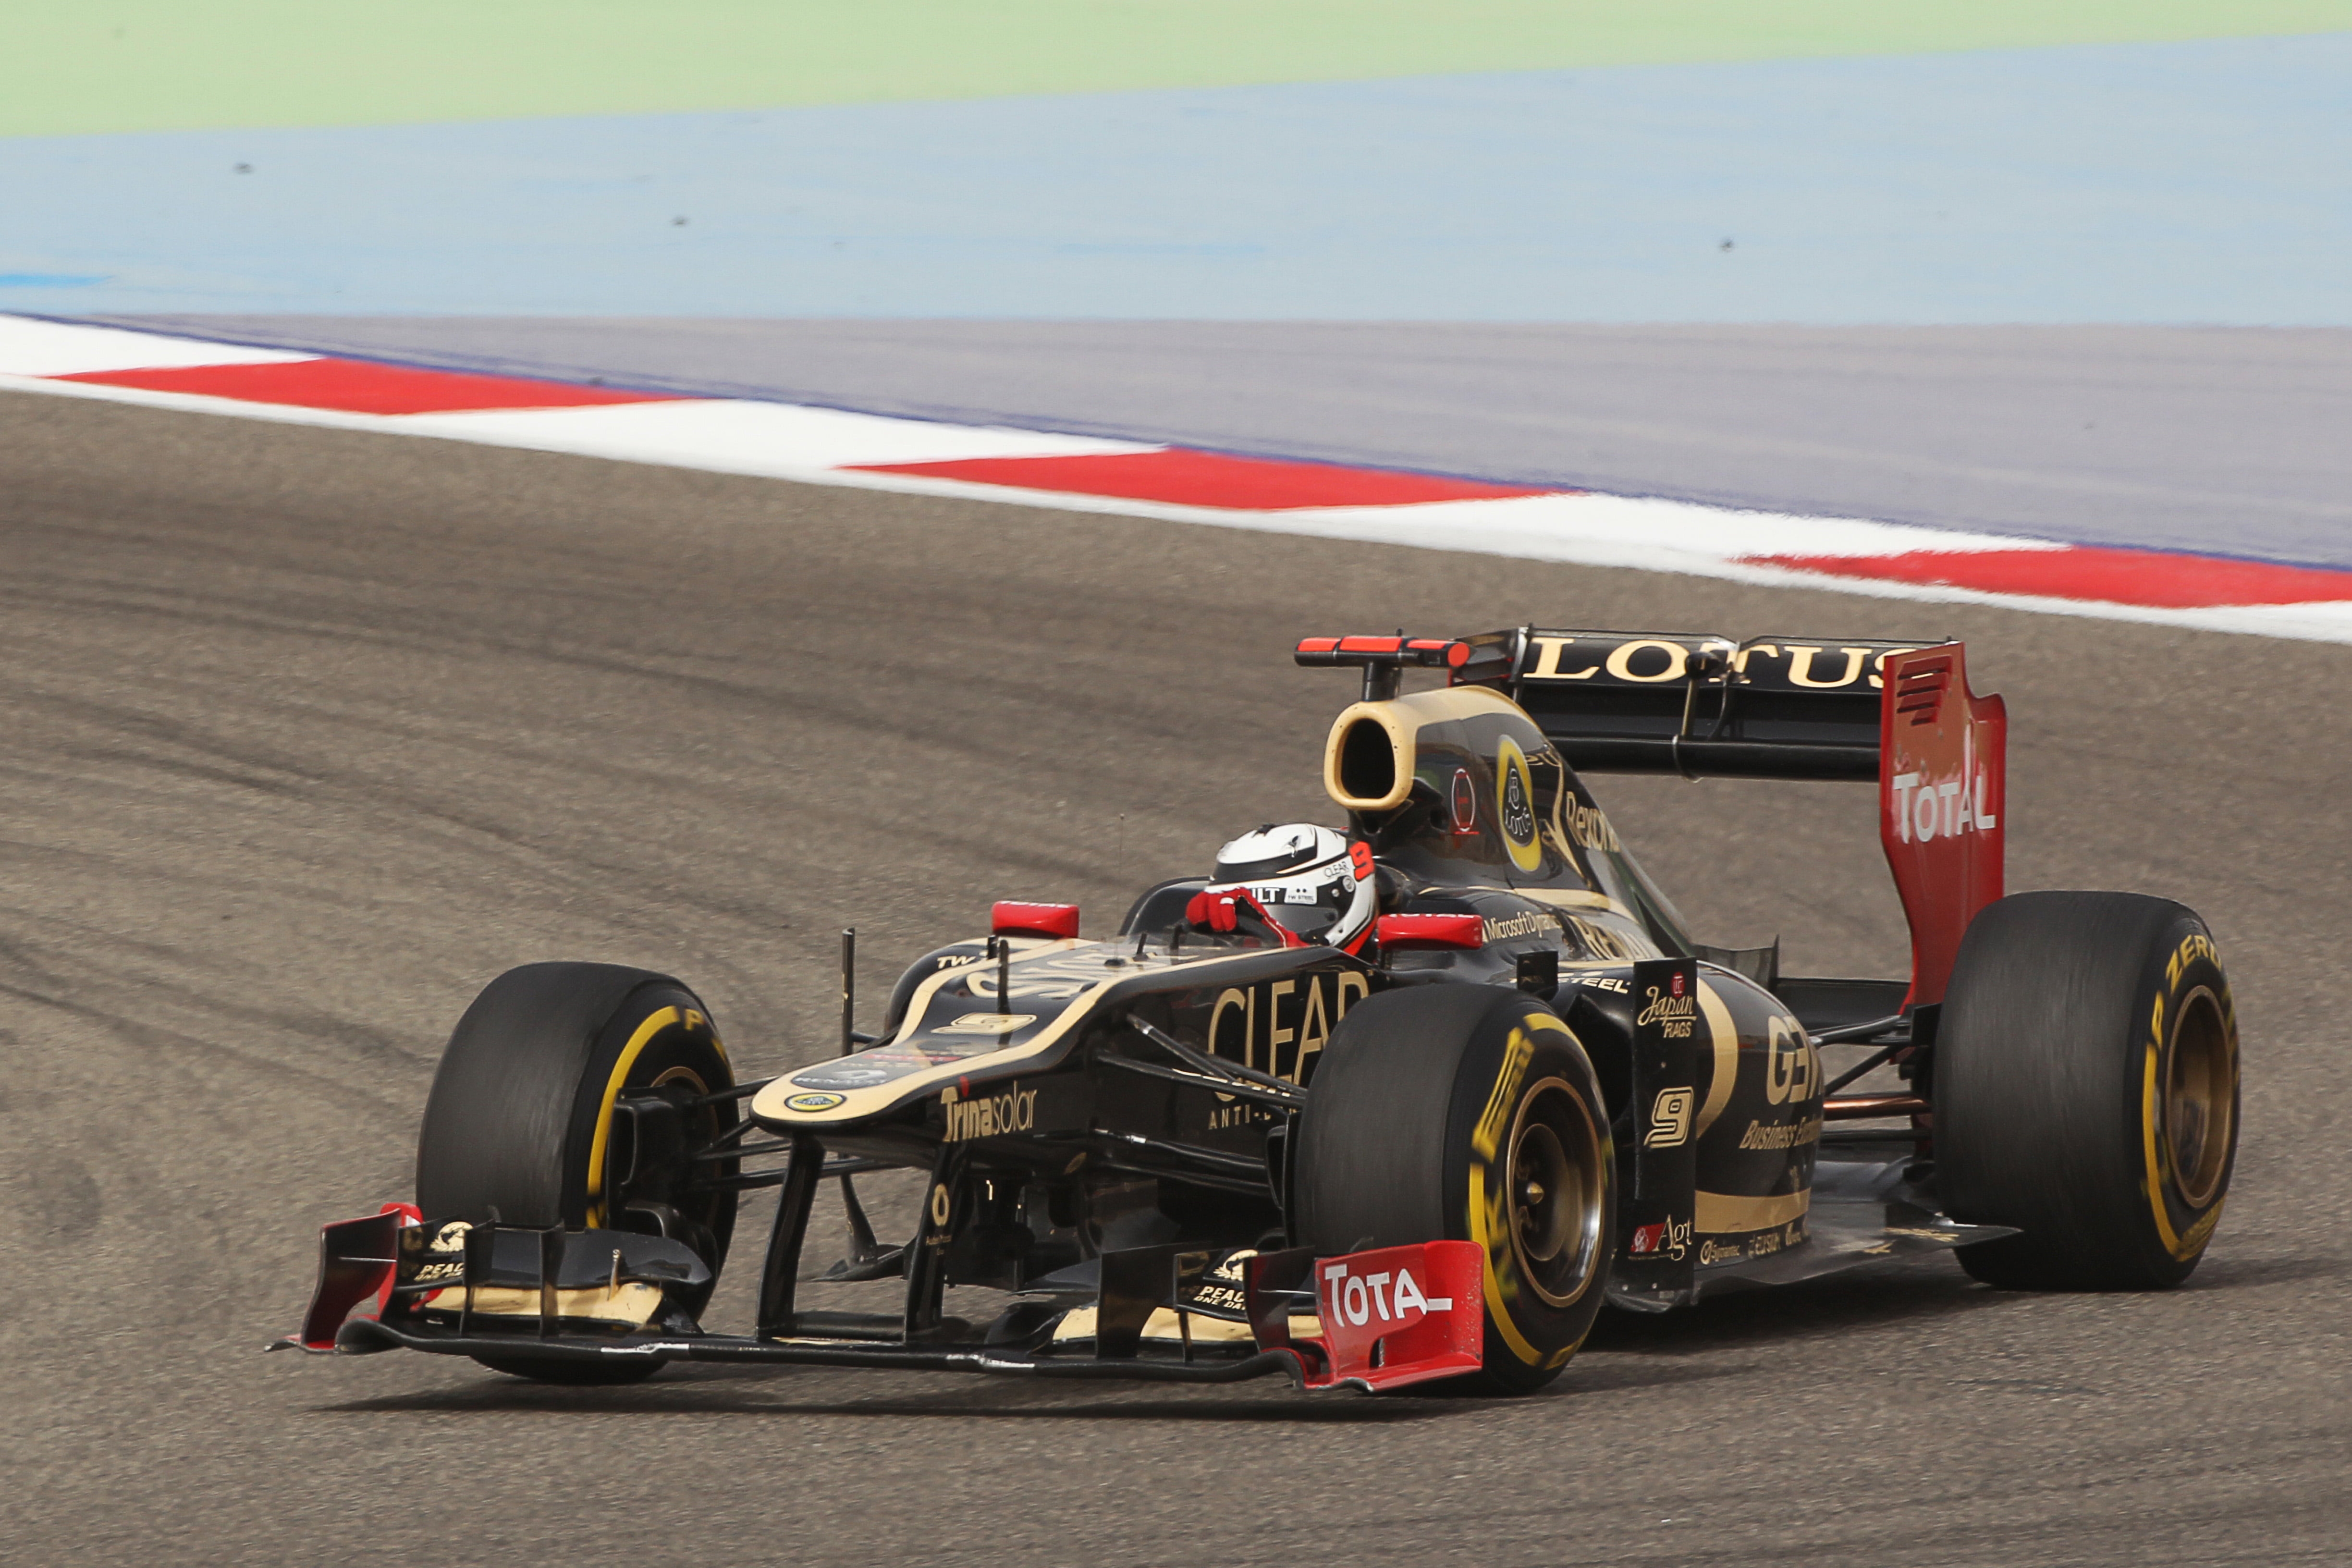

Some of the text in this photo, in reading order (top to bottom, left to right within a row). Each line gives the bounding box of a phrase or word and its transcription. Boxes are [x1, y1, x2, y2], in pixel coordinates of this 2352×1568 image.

[1566, 791, 1621, 853] Rexon
[1893, 772, 1996, 844] TOTAL
[1324, 861, 1350, 878] CLEAR
[1348, 841, 1375, 882] 9
[1484, 911, 1531, 940] Microsoft
[937, 955, 977, 969] TW
[2166, 934, 2222, 996] ZERO
[1638, 986, 1693, 1026] Japan
[1663, 1021, 1692, 1038] RAGS
[941, 1076, 1038, 1143] Trinasolar
[1643, 1086, 1694, 1149] 9
[1739, 1119, 1797, 1149] Business
[1652, 1214, 1692, 1261] Agt
[420, 1262, 465, 1274] PEAC
[1193, 1296, 1246, 1311] ONE DA
[1199, 1286, 1245, 1303] PEAC
